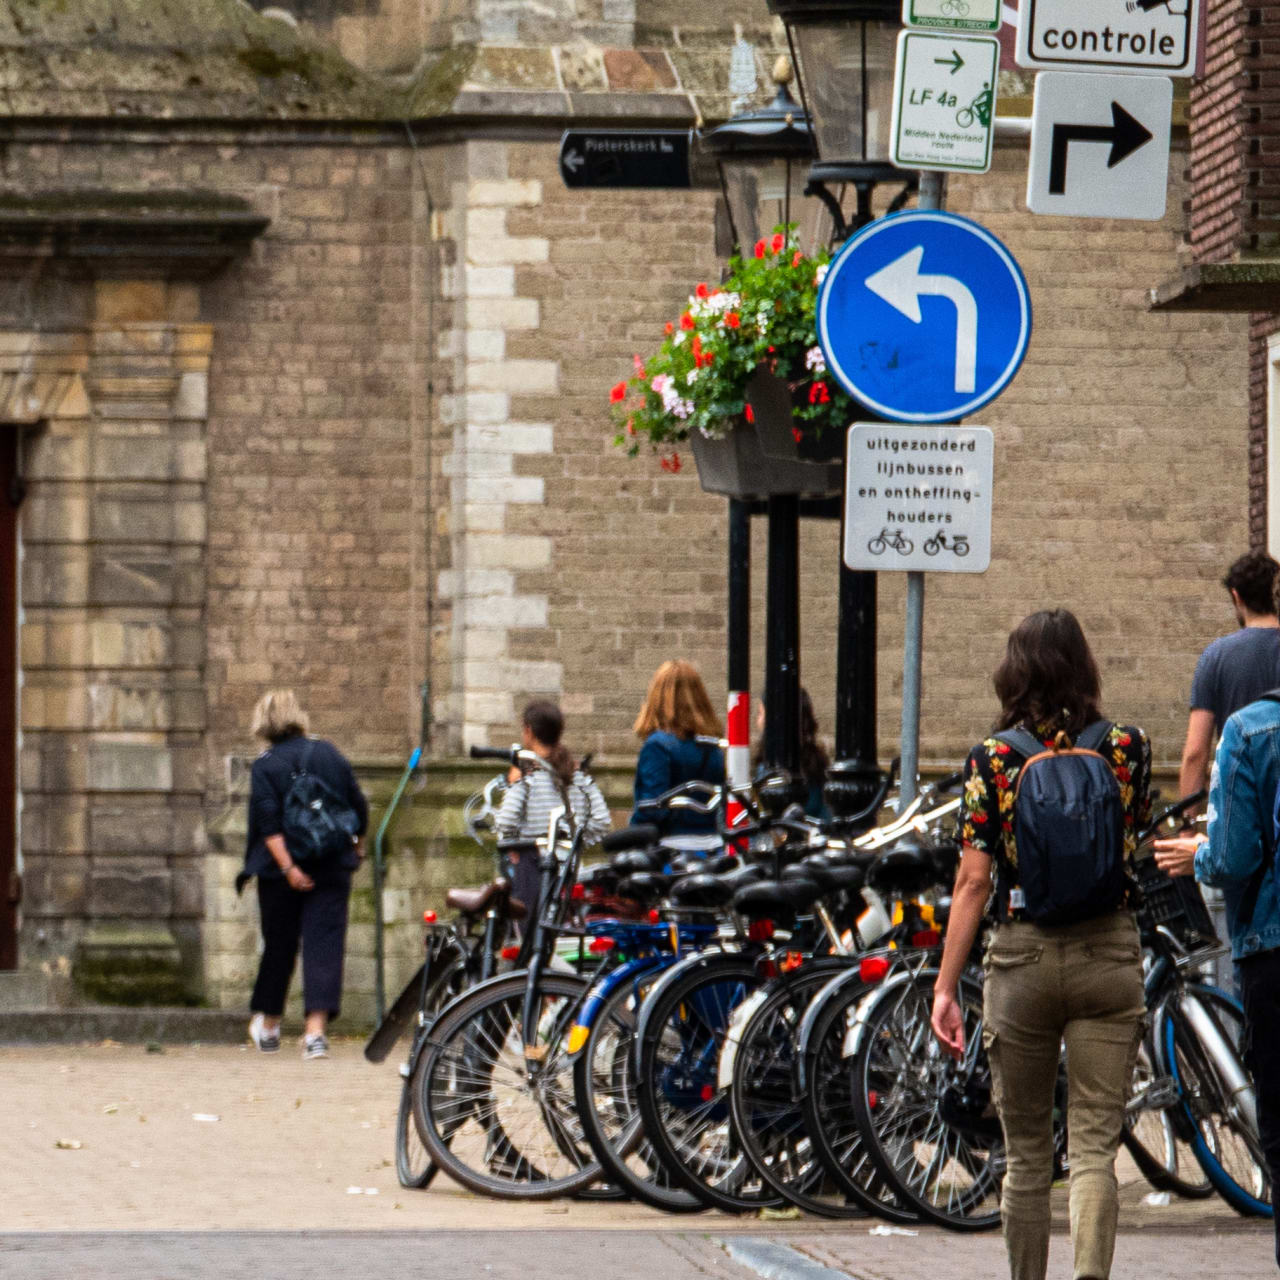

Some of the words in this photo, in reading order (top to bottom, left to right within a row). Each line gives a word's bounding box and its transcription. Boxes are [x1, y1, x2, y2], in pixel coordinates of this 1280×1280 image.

[1043, 25, 1175, 56] controle
[909, 89, 933, 106] LF
[936, 90, 958, 108] 4a
[904, 128, 936, 138] Midden
[939, 130, 984, 143] Nederland
[585, 139, 658, 152] Pieterskerk
[931, 141, 954, 149] route
[867, 439, 976, 453] uitgezonderd
[877, 462, 964, 478] lijnbussen
[858, 487, 878, 498] en
[884, 487, 981, 503] ontheffing-
[887, 511, 953, 523] houders
